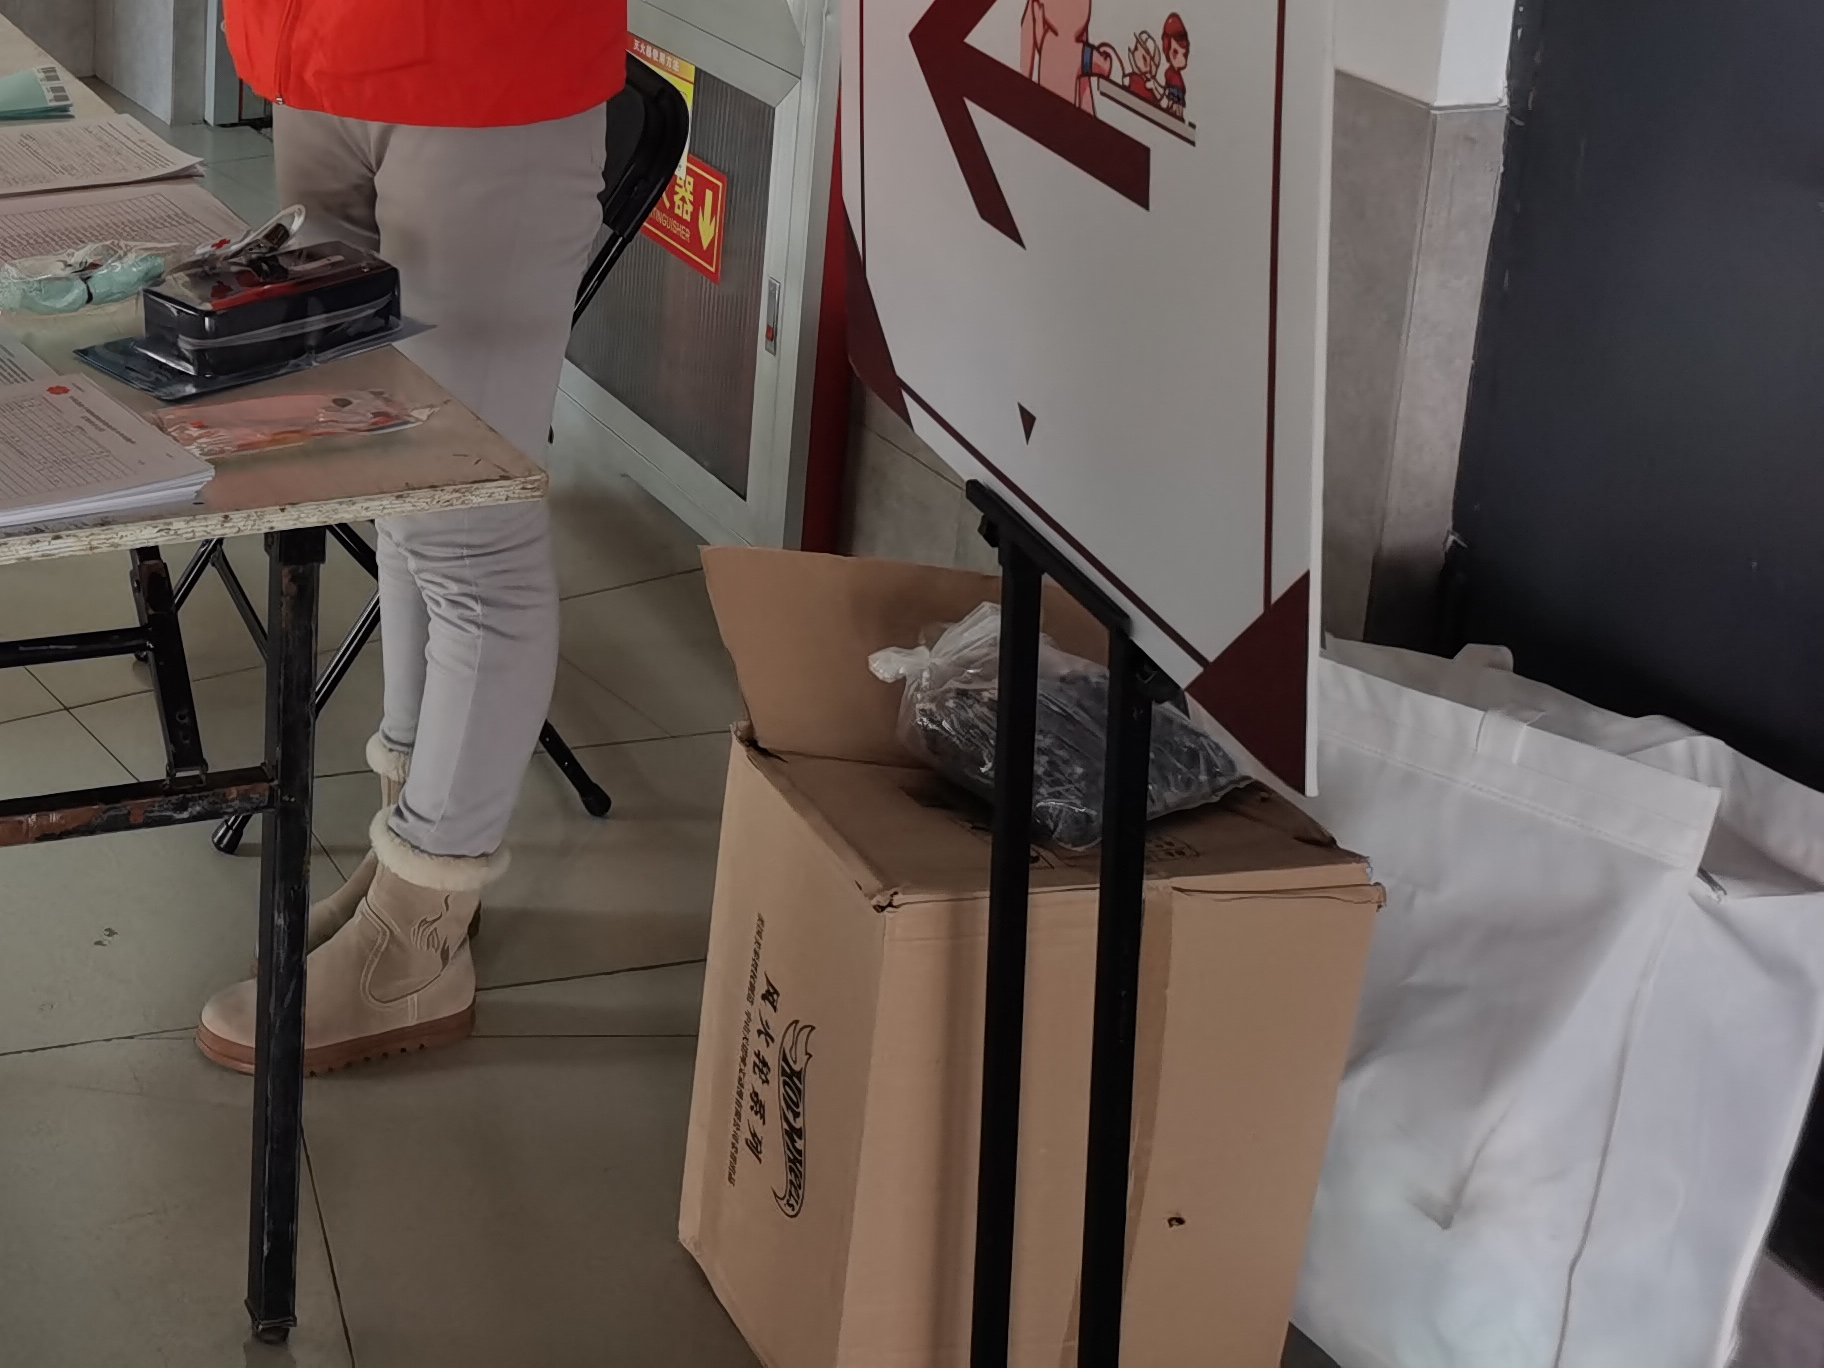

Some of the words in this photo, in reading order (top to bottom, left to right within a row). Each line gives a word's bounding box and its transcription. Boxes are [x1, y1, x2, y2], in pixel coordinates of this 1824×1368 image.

[745, 970, 780, 1164] 风火轮系列
